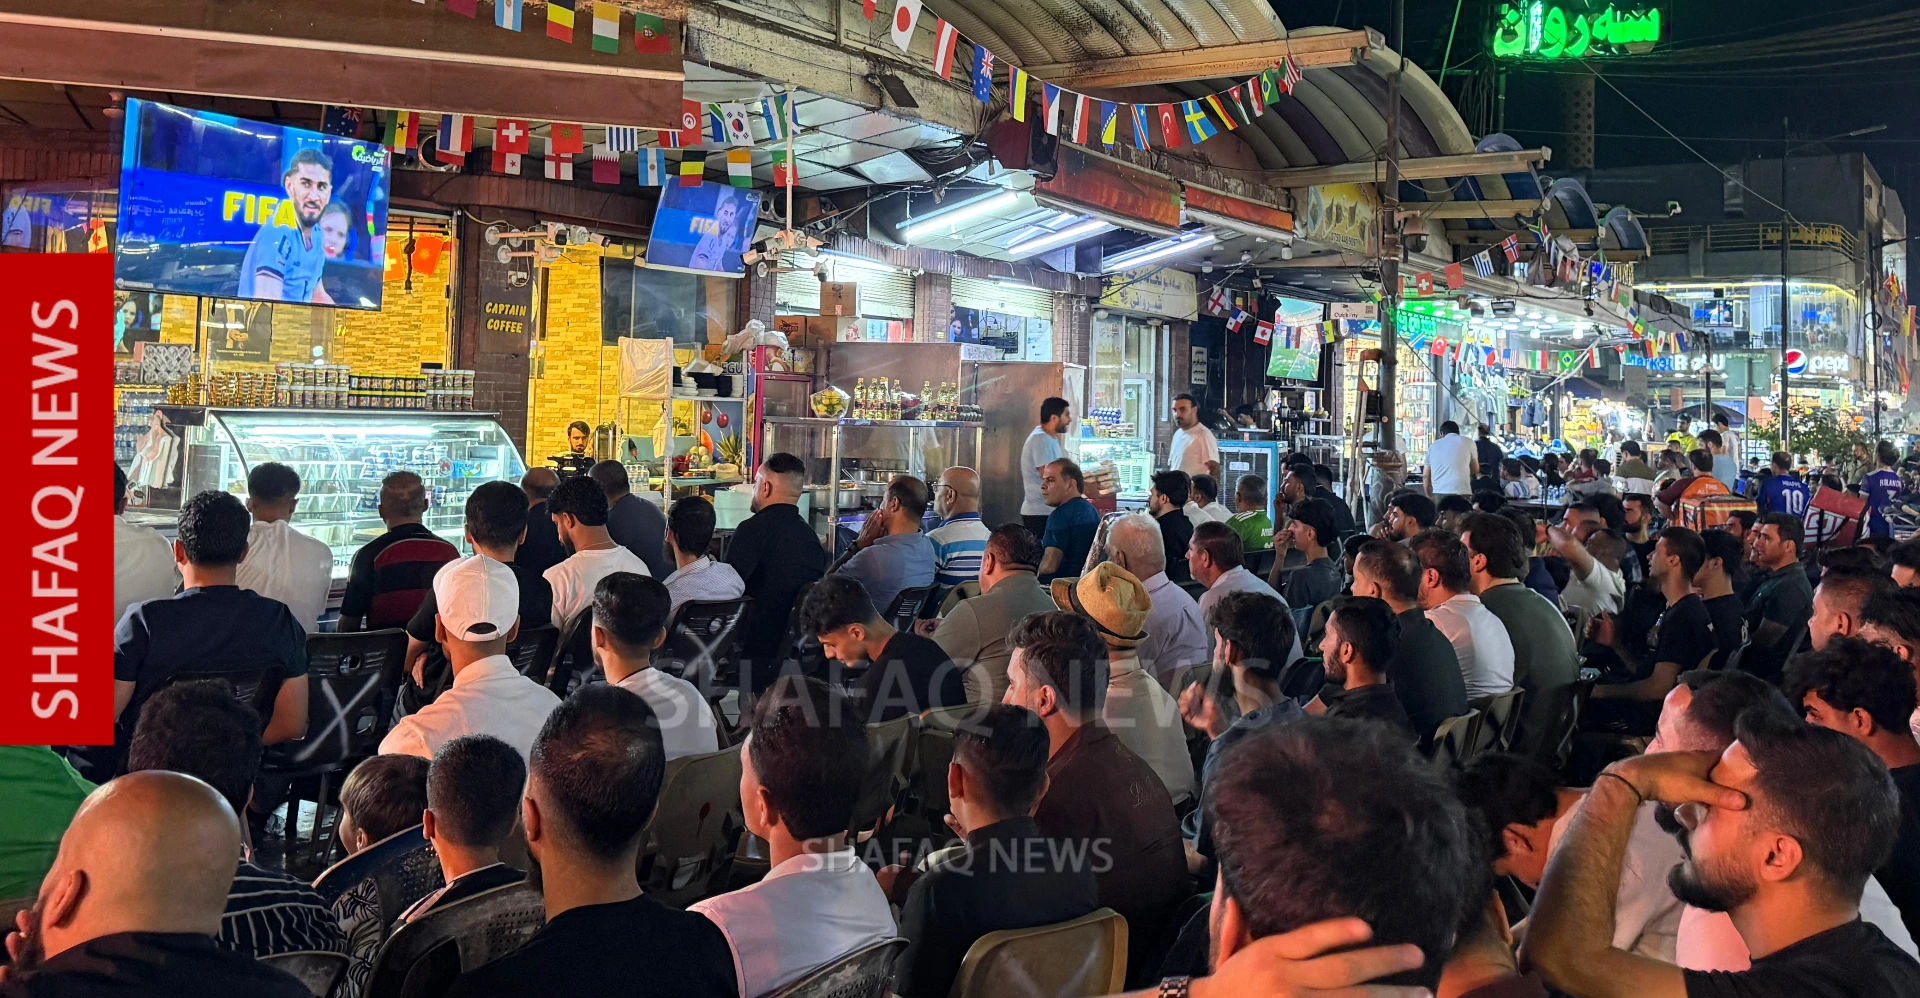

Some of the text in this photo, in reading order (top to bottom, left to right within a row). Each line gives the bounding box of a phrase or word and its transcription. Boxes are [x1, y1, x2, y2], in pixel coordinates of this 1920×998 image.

[223, 191, 298, 229] FIFA
[689, 216, 720, 236] FIFA
[485, 302, 527, 317] CAPTAIN
[486, 318, 523, 334] COFFEE
[1781, 489, 1804, 516] 10
